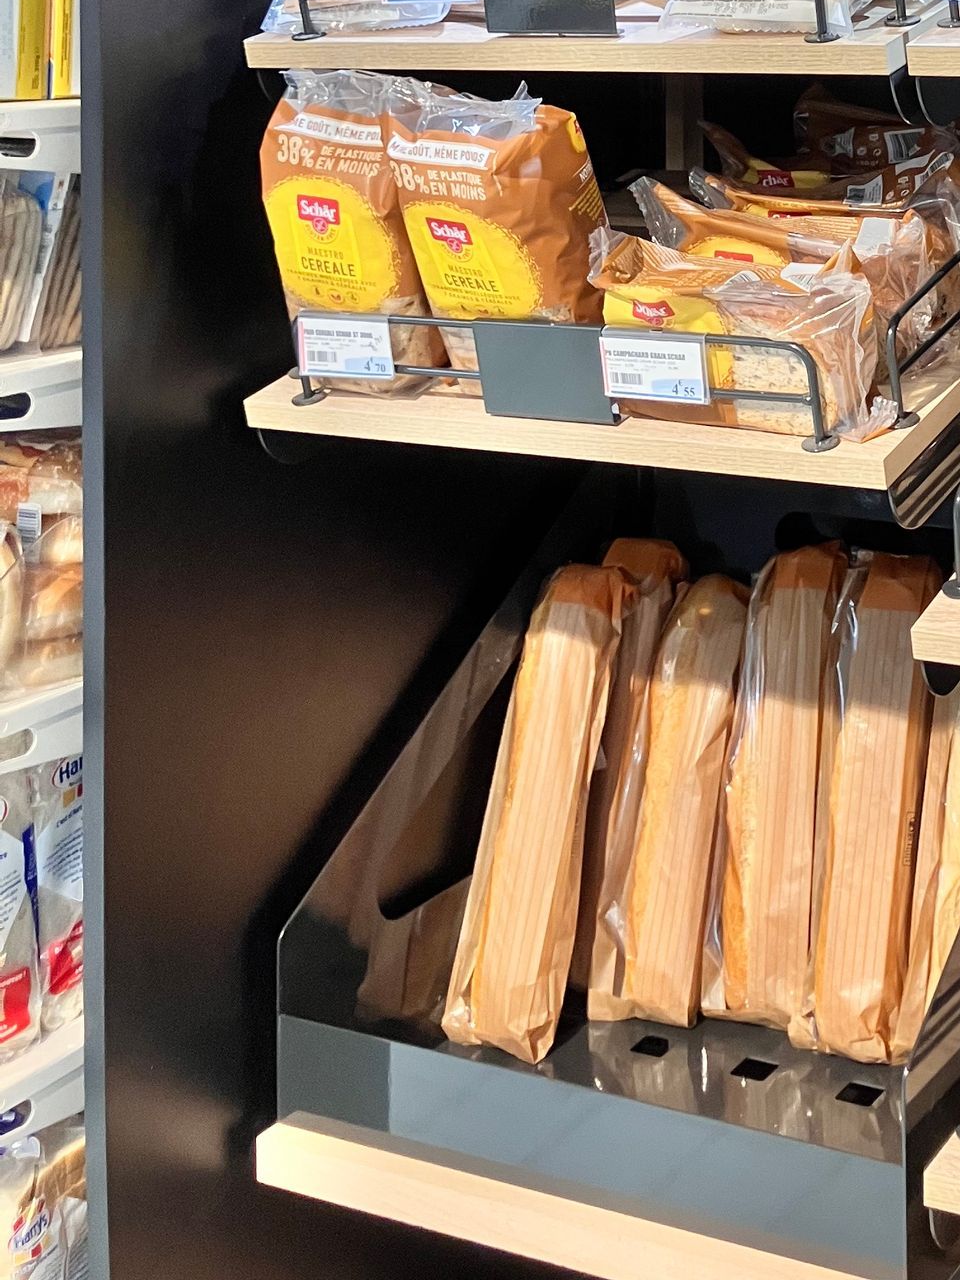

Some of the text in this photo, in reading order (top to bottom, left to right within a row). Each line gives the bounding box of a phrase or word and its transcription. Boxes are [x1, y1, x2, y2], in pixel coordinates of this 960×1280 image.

[335, 127, 365, 141] MÊME
[320, 145, 333, 156] DE
[335, 146, 384, 162] PLASTIQUE
[434, 147, 458, 160] MÊME
[460, 150, 485, 163] POIDS
[315, 158, 380, 177] EN MOINS
[427, 169, 439, 180] DE
[440, 170, 482, 186] PLASTIQUE
[430, 181, 487, 201] EN MOINS
[300, 200, 337, 222] Schär
[430, 221, 467, 242] Schär
[301, 256, 356, 277] CEREALE
[444, 273, 499, 293] CEREALE
